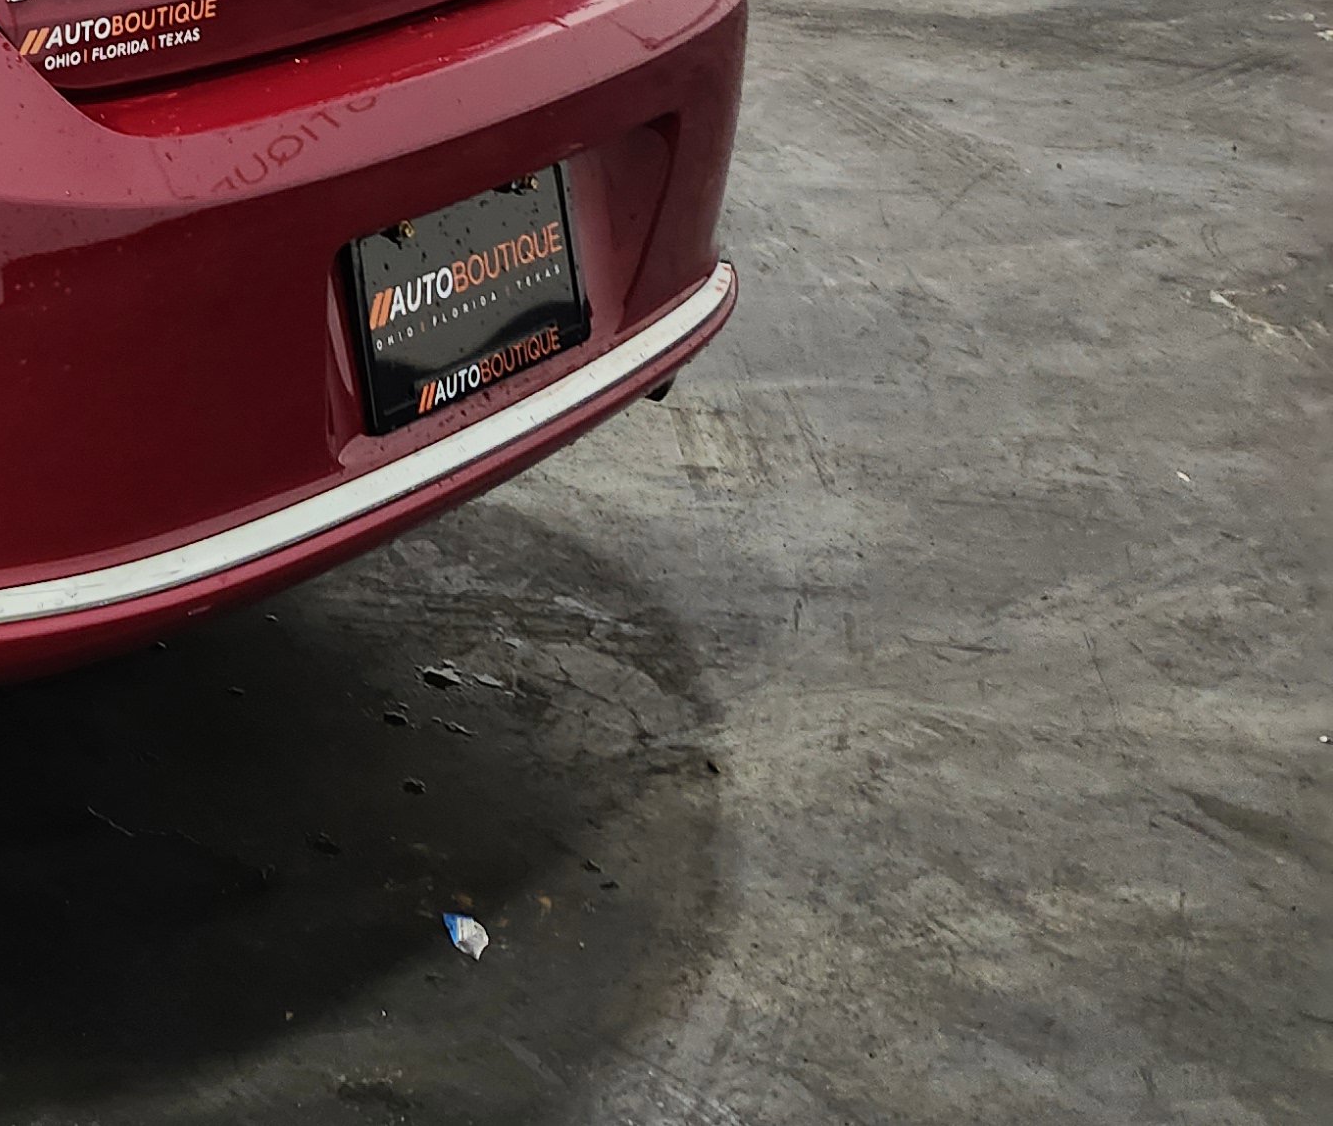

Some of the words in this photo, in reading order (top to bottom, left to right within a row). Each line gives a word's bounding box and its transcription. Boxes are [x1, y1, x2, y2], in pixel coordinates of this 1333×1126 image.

[44, 51, 82, 71] OHIO
[91, 39, 150, 62] FLORIDA
[158, 27, 201, 49] TEXAS
[376, 326, 414, 351] OHIO
[432, 290, 497, 327] FLORIDA
[516, 263, 561, 290] TEXAS
[389, 221, 563, 321] AUTOBOUTIQUE
[434, 326, 562, 406] AUTOBOUTIQUE
